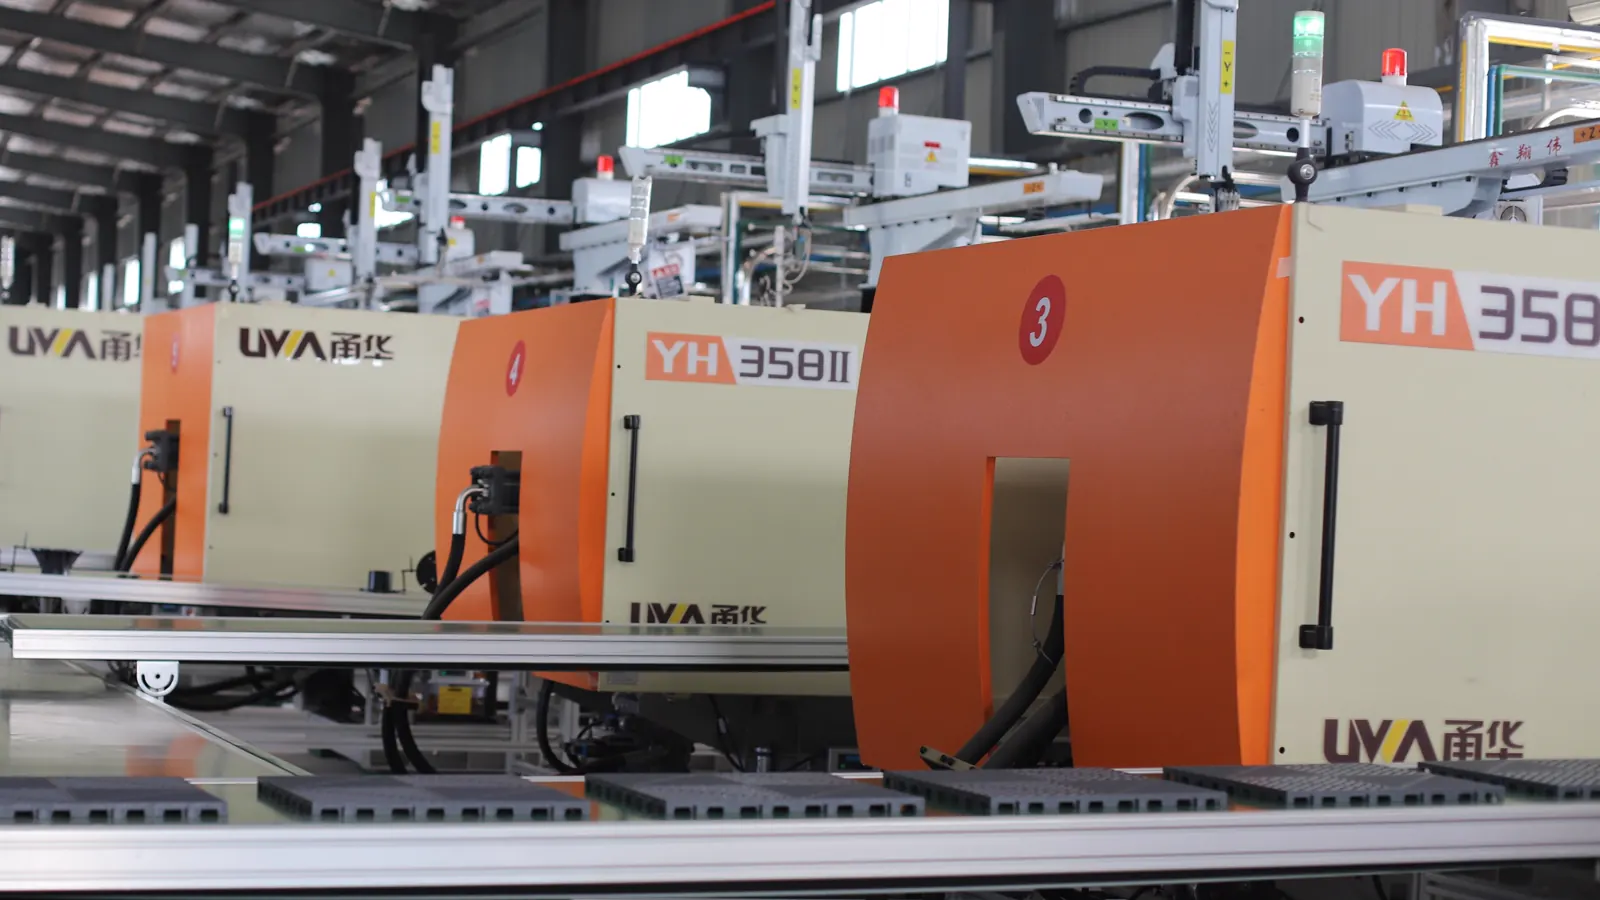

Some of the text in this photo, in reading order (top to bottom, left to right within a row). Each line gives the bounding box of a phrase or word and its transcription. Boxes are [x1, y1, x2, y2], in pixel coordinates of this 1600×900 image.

[1029, 296, 1051, 348] 3
[1348, 274, 1448, 336] YH
[101, 330, 141, 361] 甬
[331, 332, 394, 362] 甬华
[652, 339, 718, 376] YH
[509, 352, 521, 385] 4
[1443, 720, 1524, 761] 甬华
